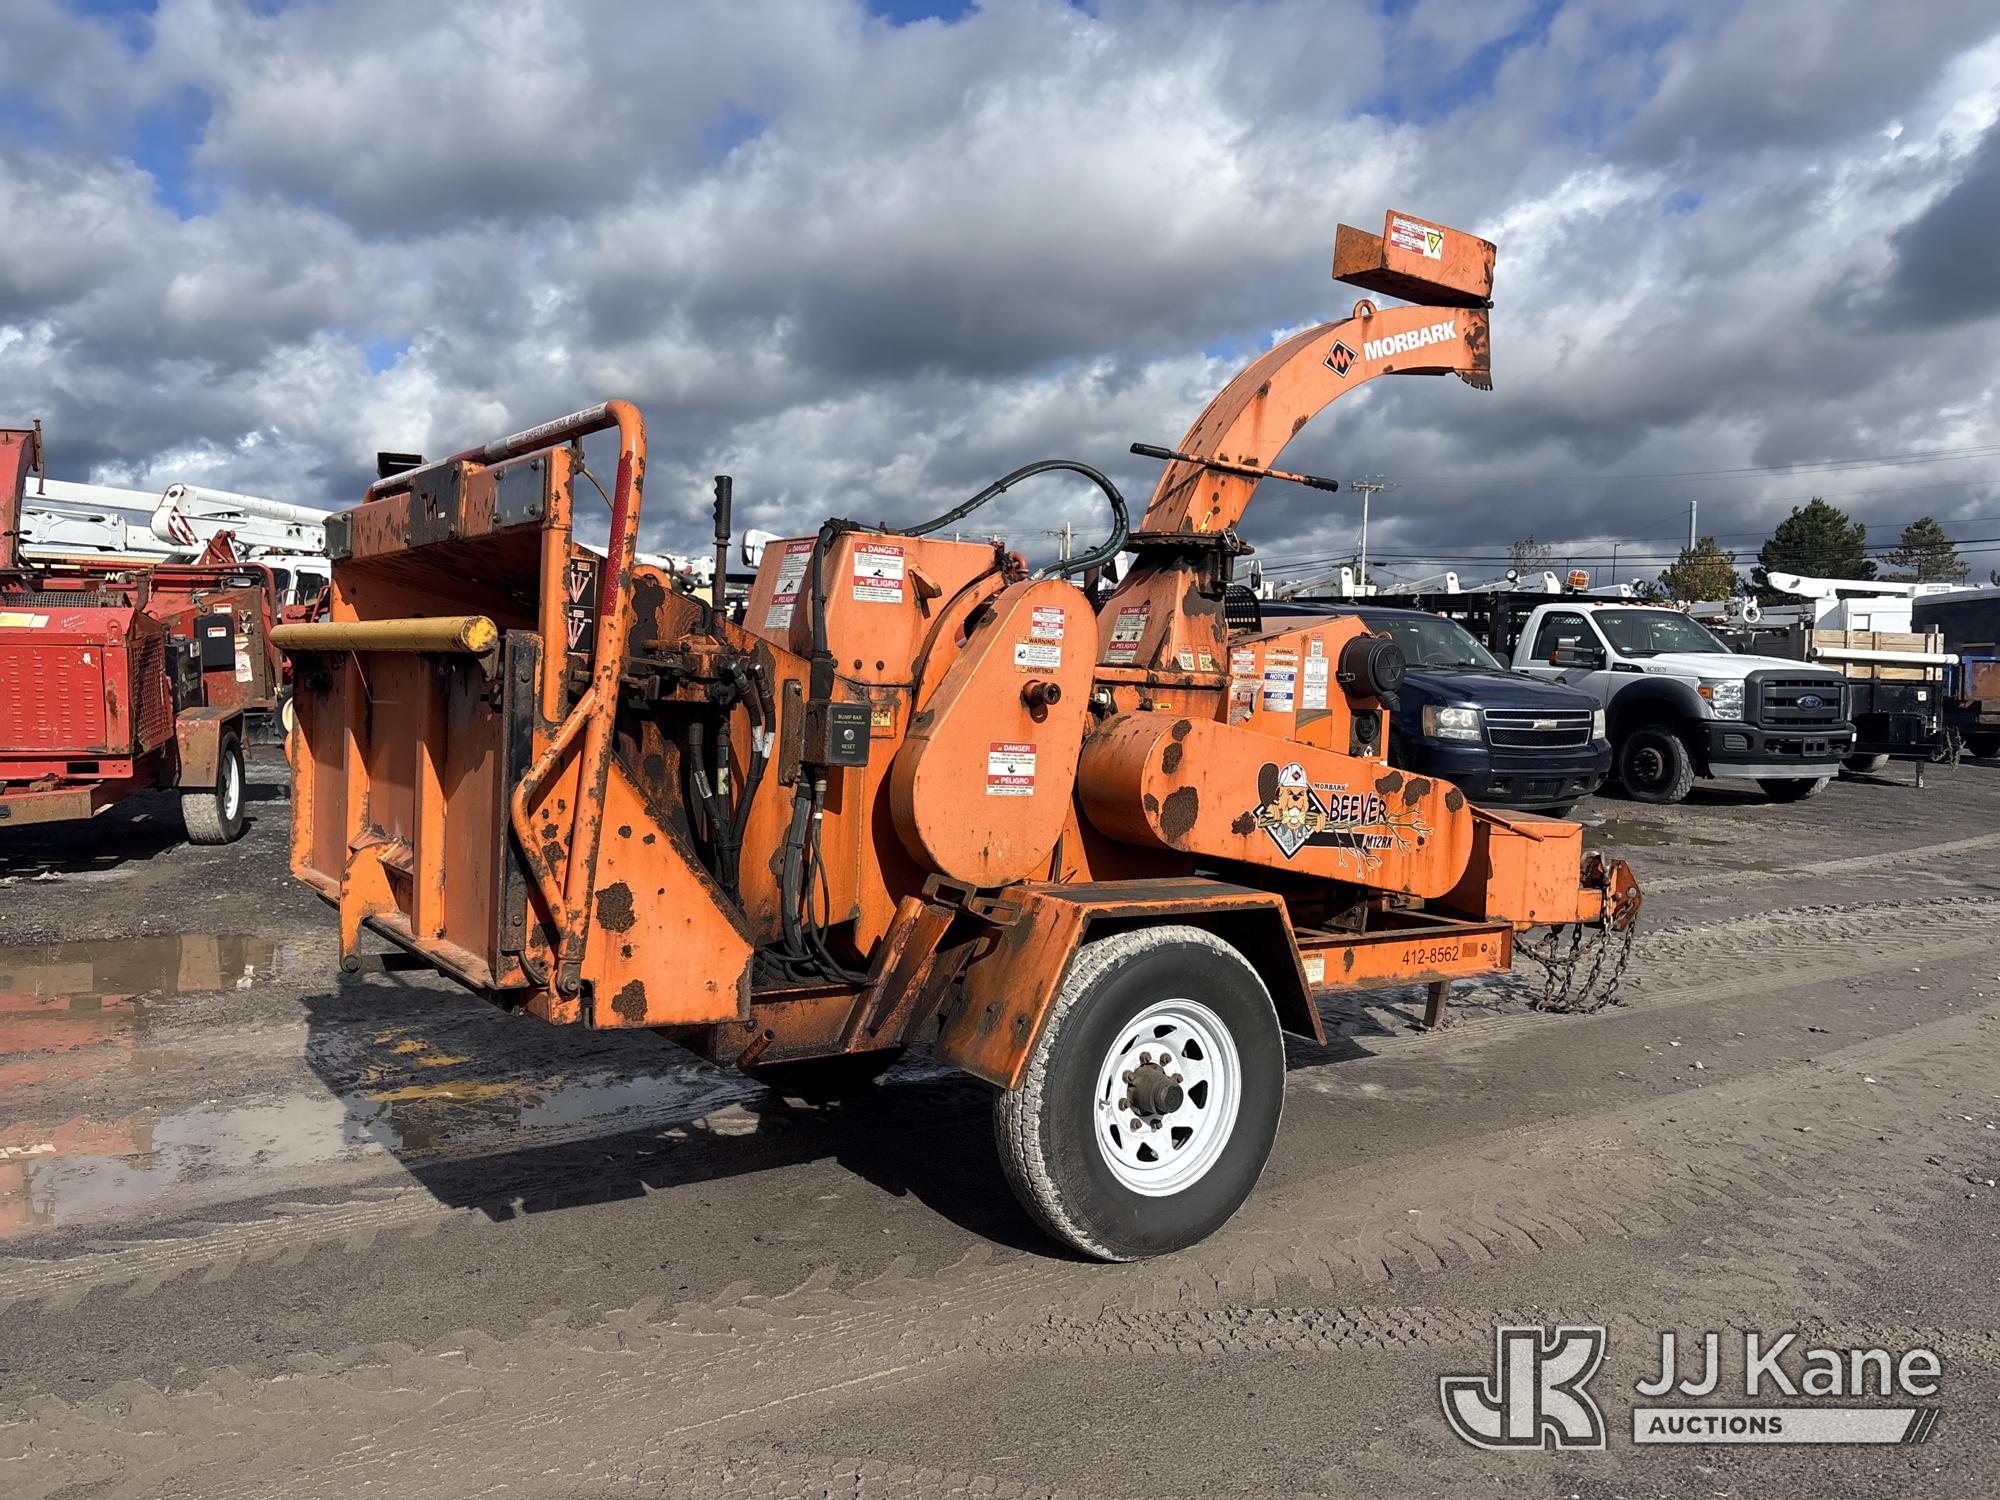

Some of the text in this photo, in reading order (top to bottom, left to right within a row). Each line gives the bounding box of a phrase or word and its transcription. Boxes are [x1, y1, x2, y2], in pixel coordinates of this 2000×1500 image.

[1363, 320, 1457, 361] MORBARK
[792, 544, 811, 552] DANGER
[868, 545, 900, 555] DANGER
[866, 578, 899, 588] PELIGRO
[1001, 777, 1029, 785] PELIGRO
[1314, 783, 1346, 791] MORBARK
[1329, 792, 1387, 826] BEEVER
[1365, 835, 1393, 848] M12RX
[1402, 946, 1459, 965] 412-8562
